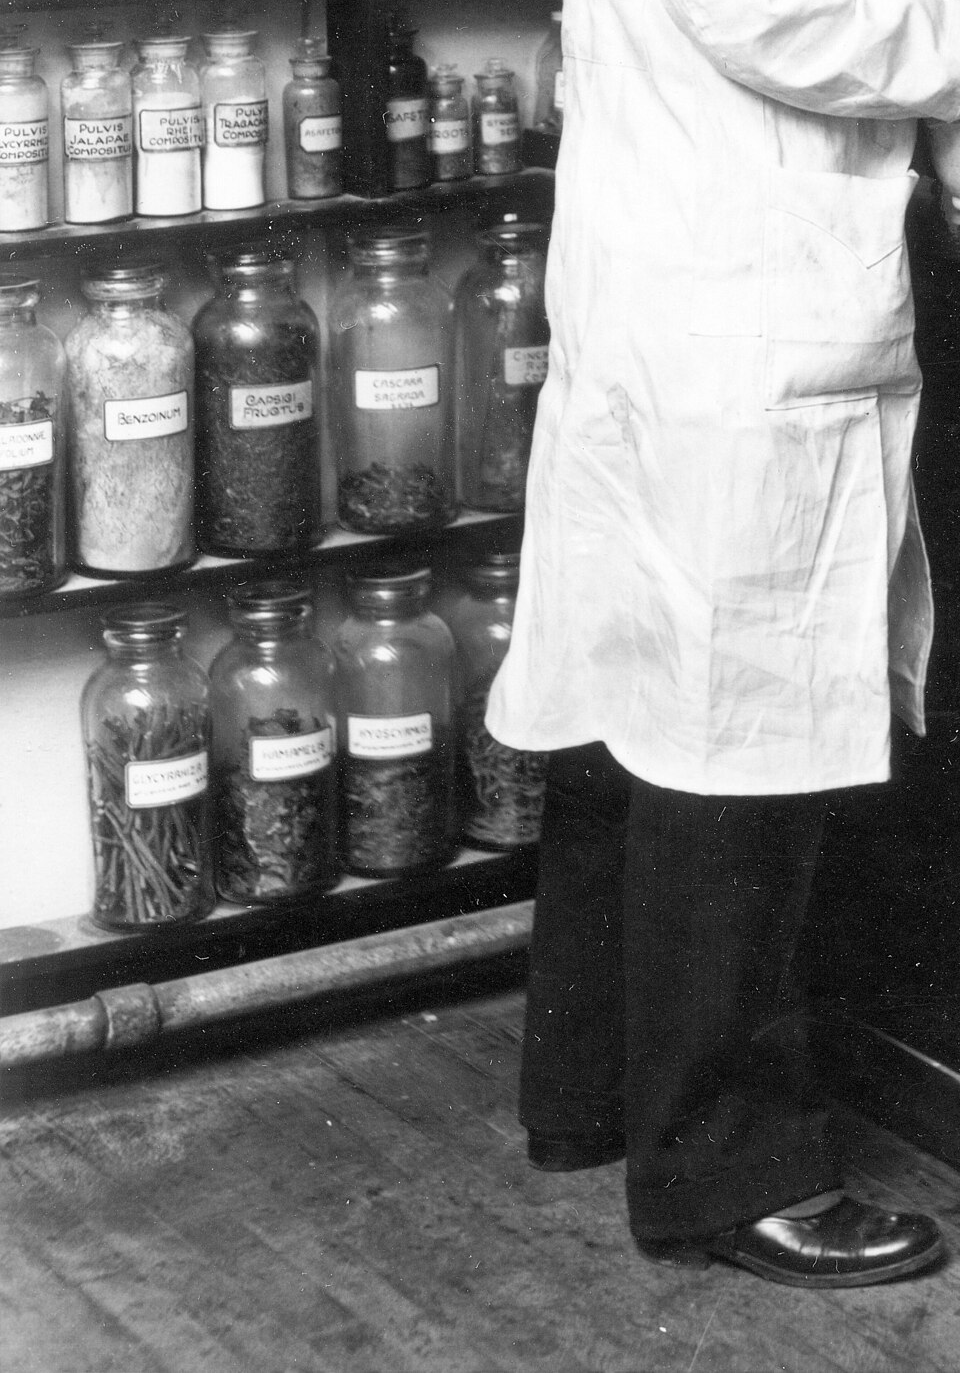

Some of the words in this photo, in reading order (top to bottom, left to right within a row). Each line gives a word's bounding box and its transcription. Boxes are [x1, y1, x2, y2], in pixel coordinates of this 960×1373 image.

[159, 114, 200, 126] PULVIS
[4, 125, 47, 137] PULVIS
[79, 122, 124, 134] PULVIS
[166, 127, 192, 136] RHEI
[70, 133, 129, 146] JALAPAE
[117, 407, 182, 427] BENZOINUM
